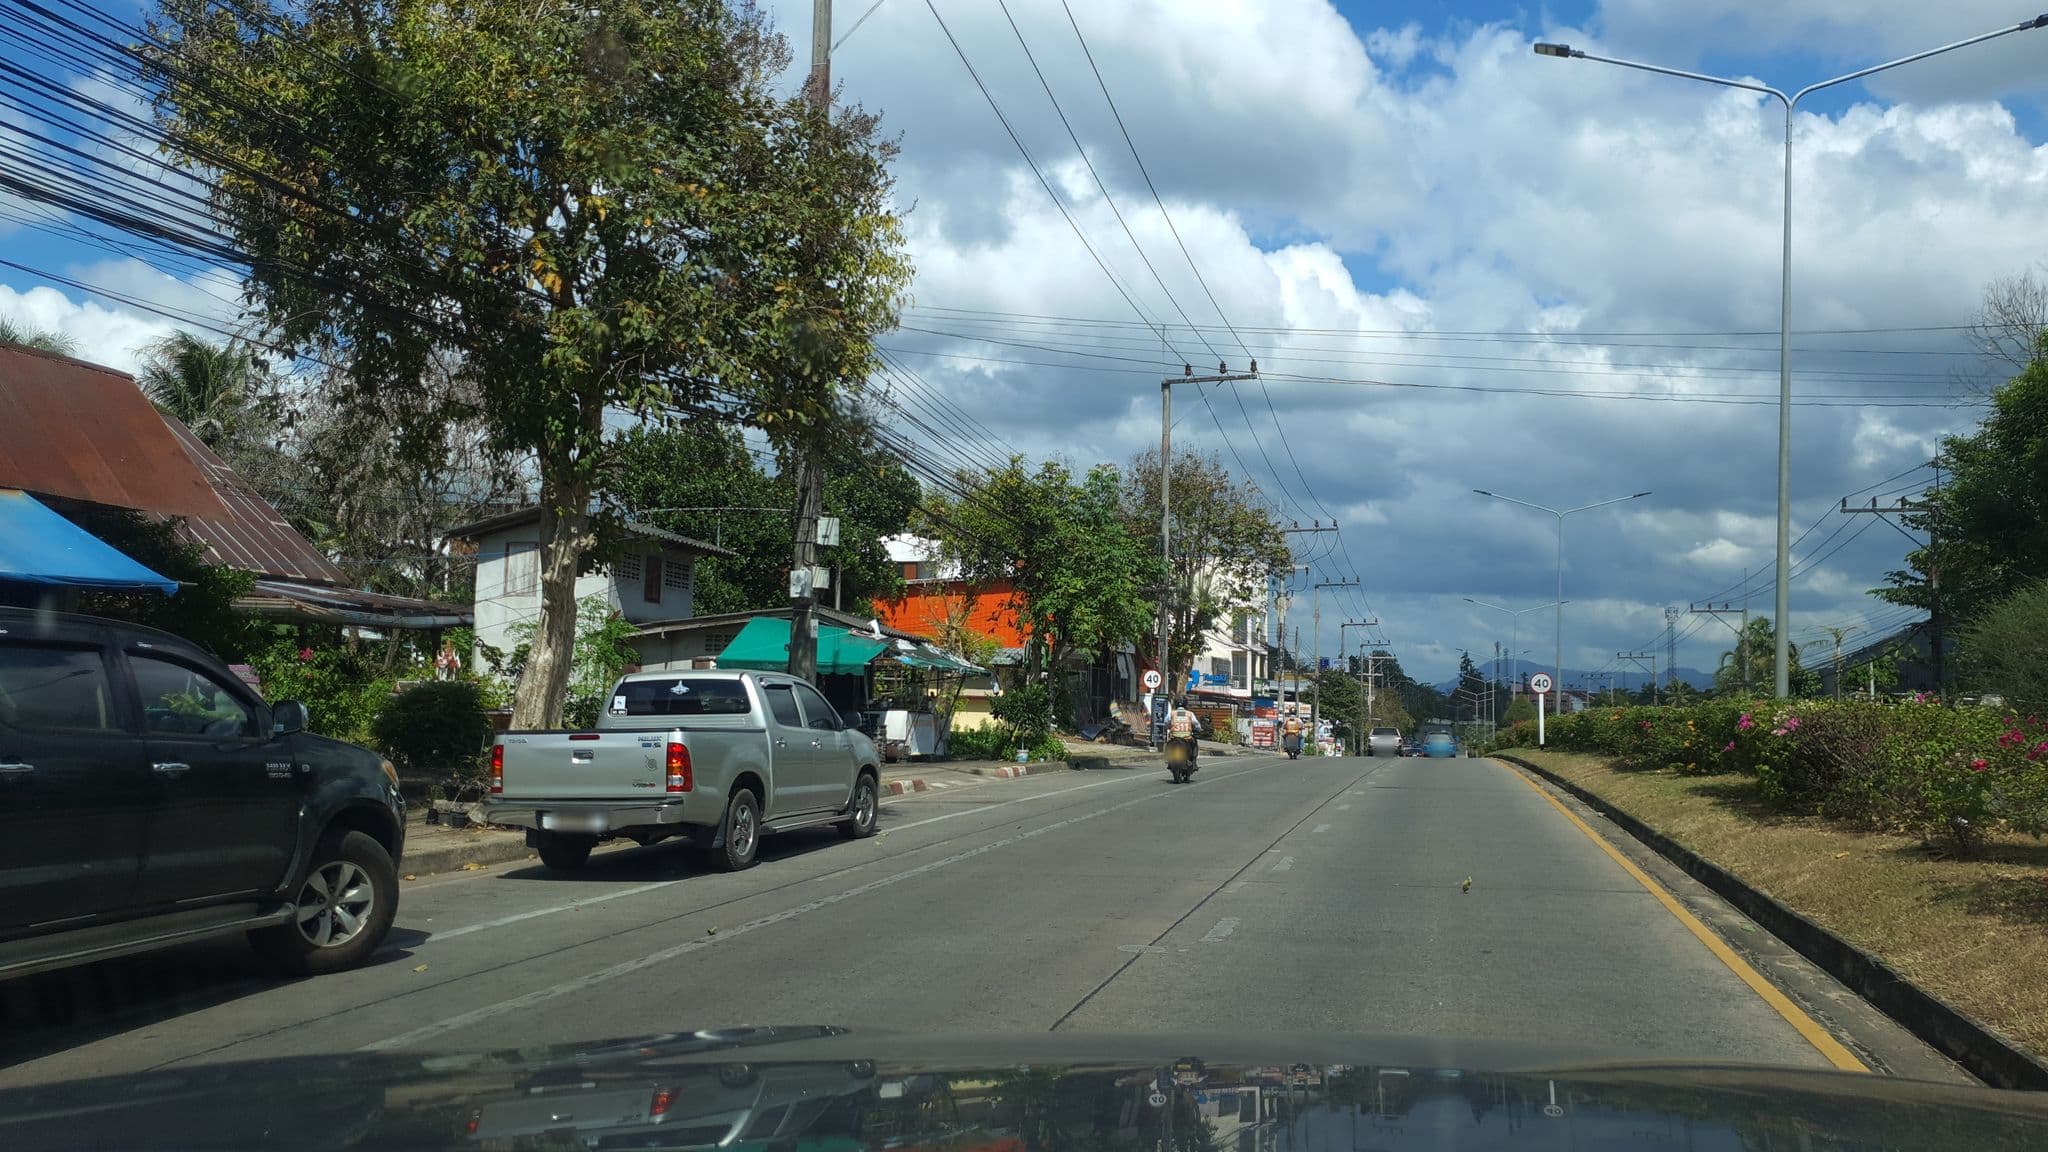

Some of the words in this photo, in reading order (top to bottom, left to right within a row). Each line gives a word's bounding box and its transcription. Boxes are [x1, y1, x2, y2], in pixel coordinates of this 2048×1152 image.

[1146, 674, 1159, 684] 40
[1534, 678, 1549, 688] 40
[1173, 722, 1190, 732] 311
